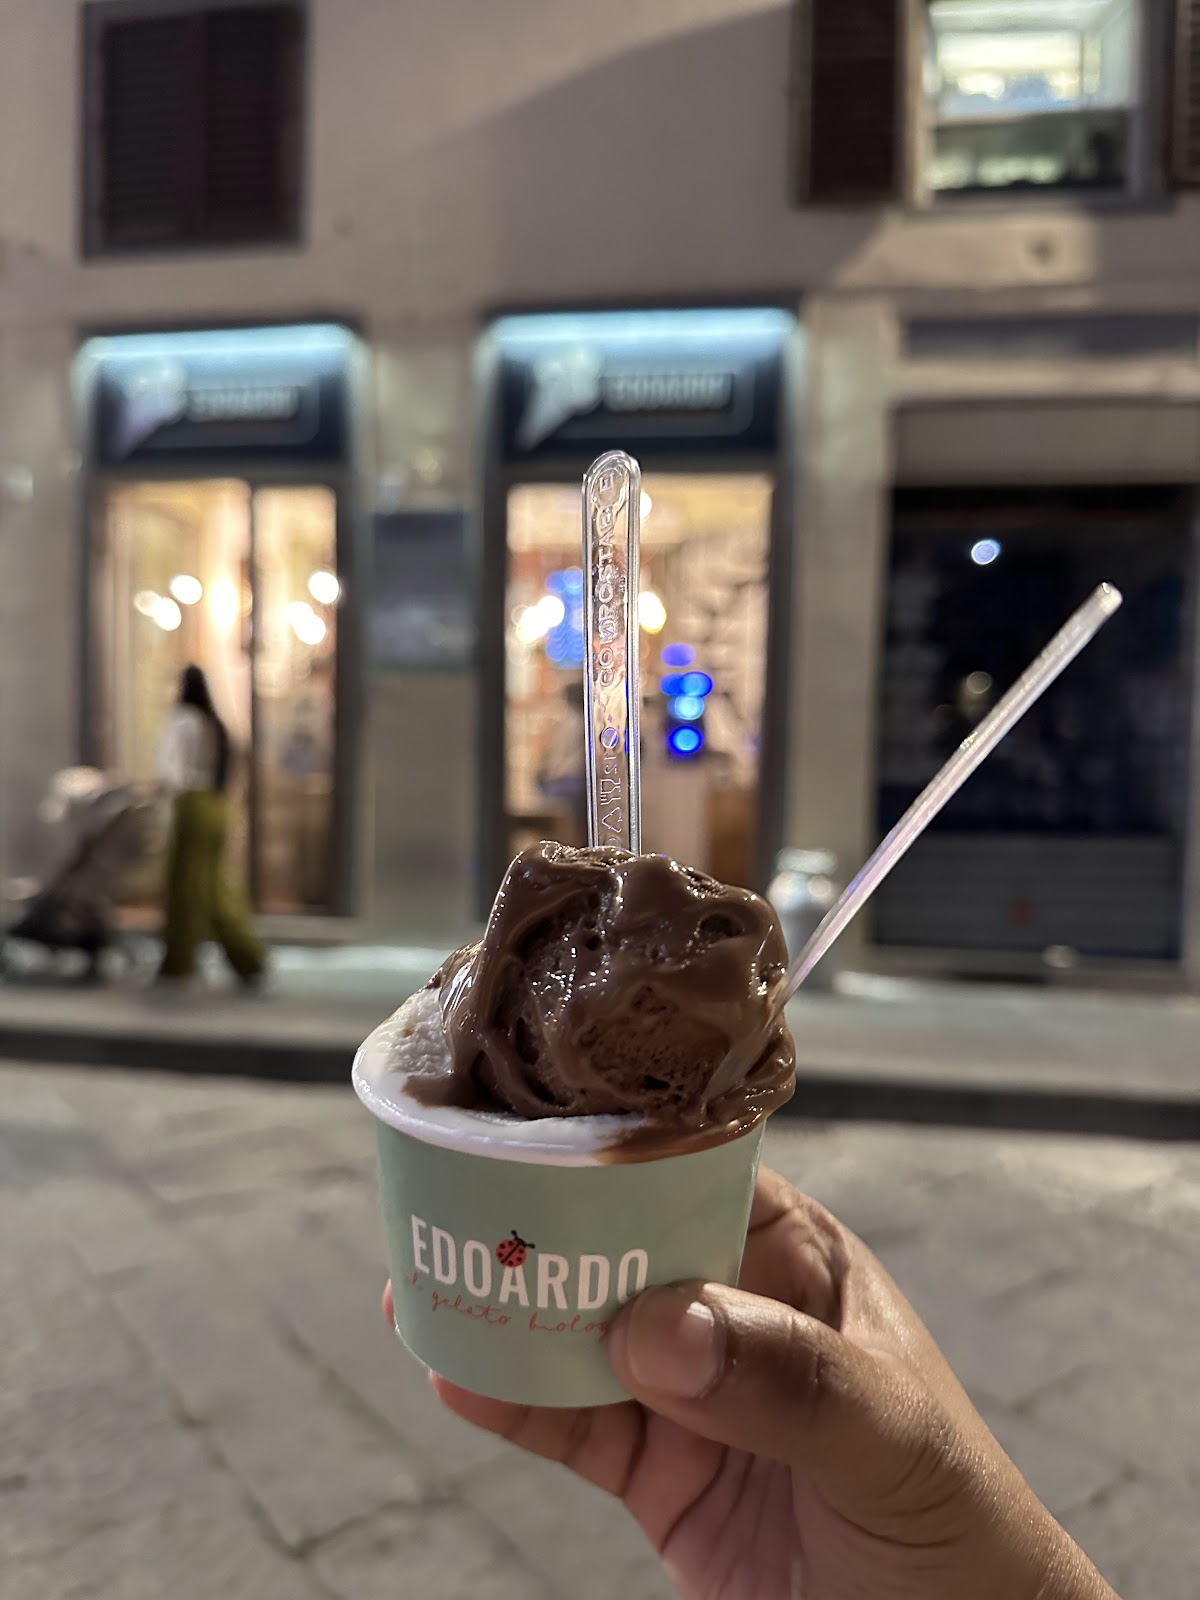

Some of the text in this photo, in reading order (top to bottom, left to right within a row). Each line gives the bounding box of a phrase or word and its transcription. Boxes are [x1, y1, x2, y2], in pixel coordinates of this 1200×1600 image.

[597, 472, 616, 688] COMPOSTABE
[411, 1213, 649, 1309] EDOARDO
[431, 1290, 512, 1326] gelato
[528, 1311, 610, 1343] biolog
